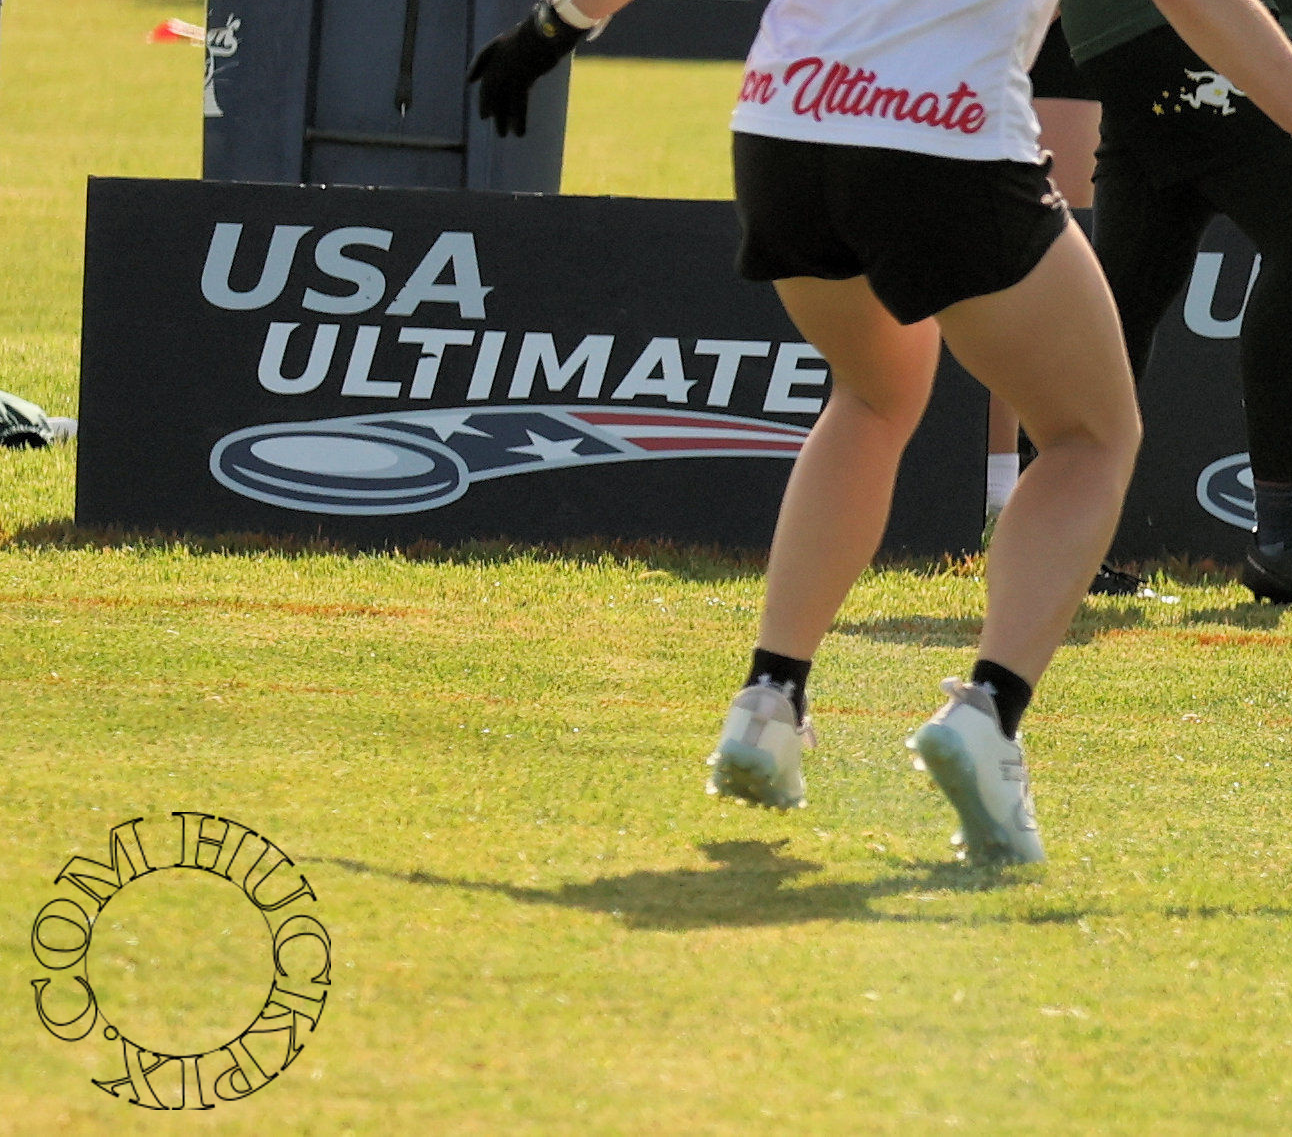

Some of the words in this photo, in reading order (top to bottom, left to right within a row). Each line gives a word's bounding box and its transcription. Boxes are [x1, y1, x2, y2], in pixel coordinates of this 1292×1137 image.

[782, 56, 986, 134] Ultimate
[201, 222, 493, 320] USA
[257, 322, 828, 414] ULTIMATE
